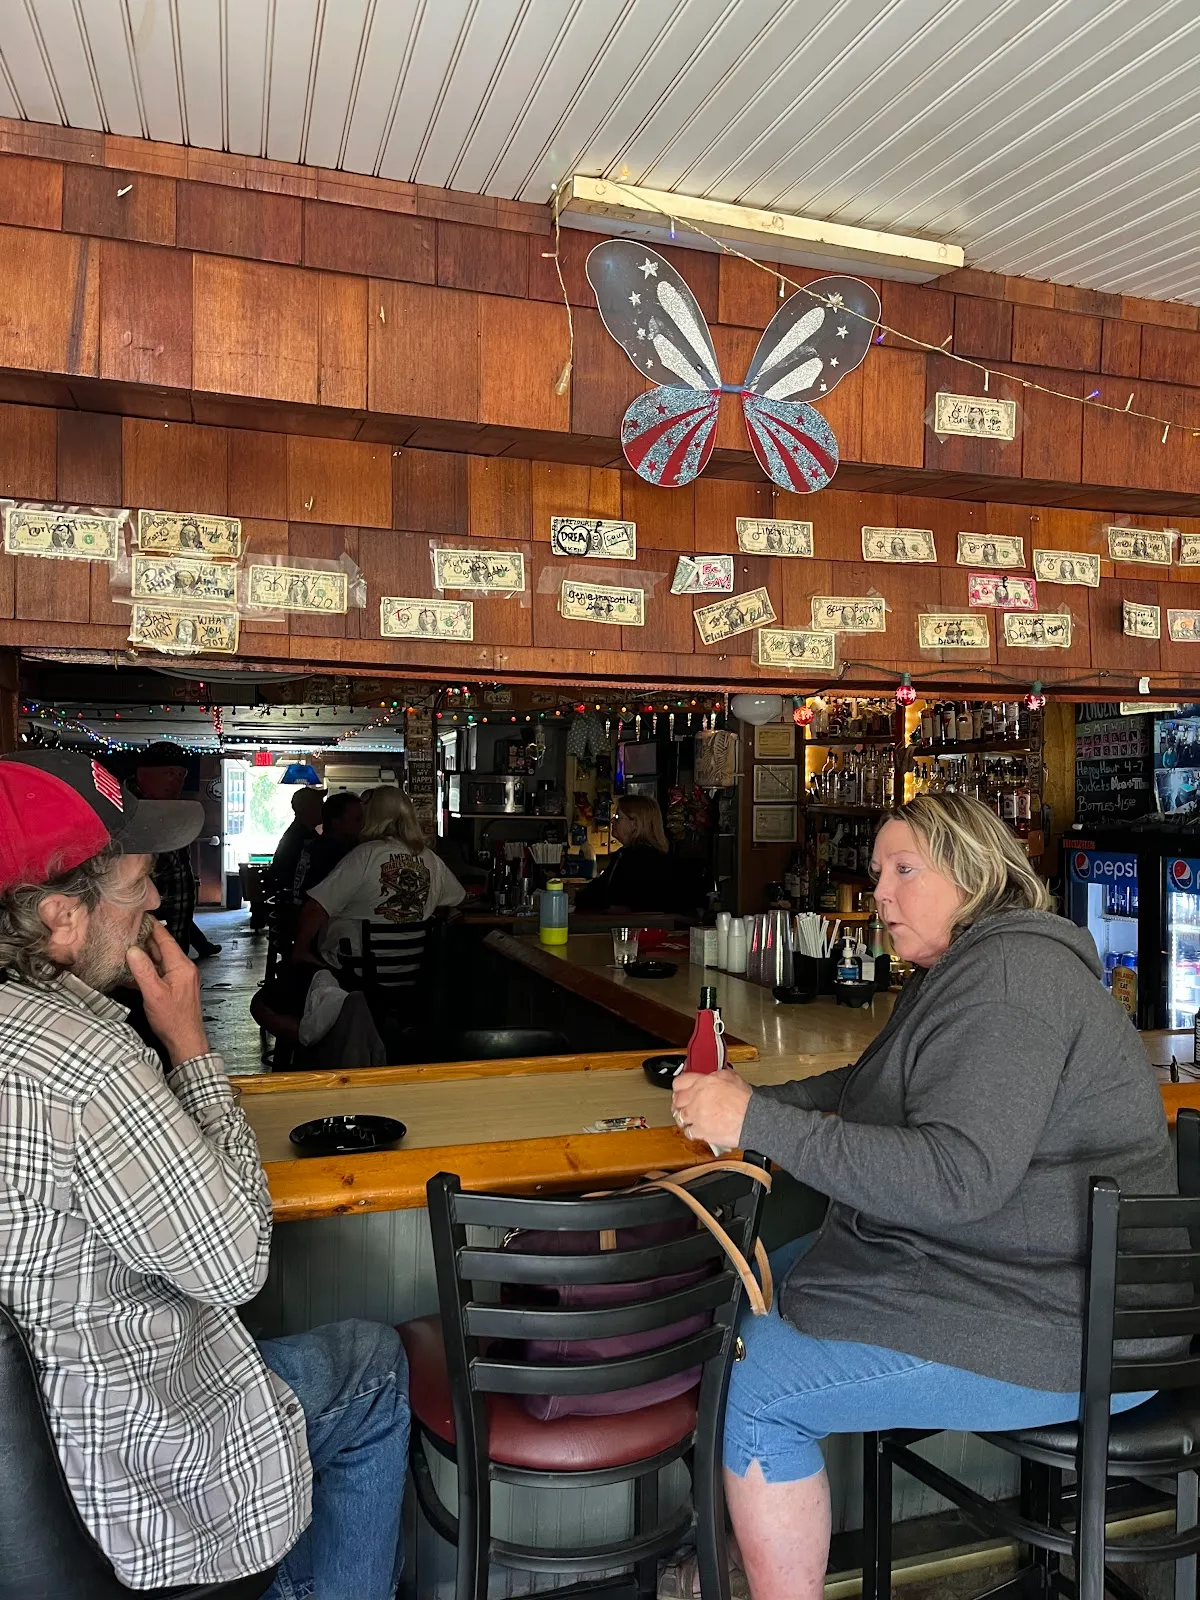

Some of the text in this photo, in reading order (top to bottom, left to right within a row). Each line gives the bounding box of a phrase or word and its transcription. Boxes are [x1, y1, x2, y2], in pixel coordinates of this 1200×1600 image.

[197, 614, 228, 625] WHAT
[202, 626, 222, 636] YOU
[256, 752, 272, 766] EXIT
[1100, 760, 1120, 773] Hour
[412, 776, 433, 784] HAPPY
[1077, 779, 1110, 793] Buckets
[414, 784, 432, 792] PLACE
[1093, 859, 1137, 880] pepsi
